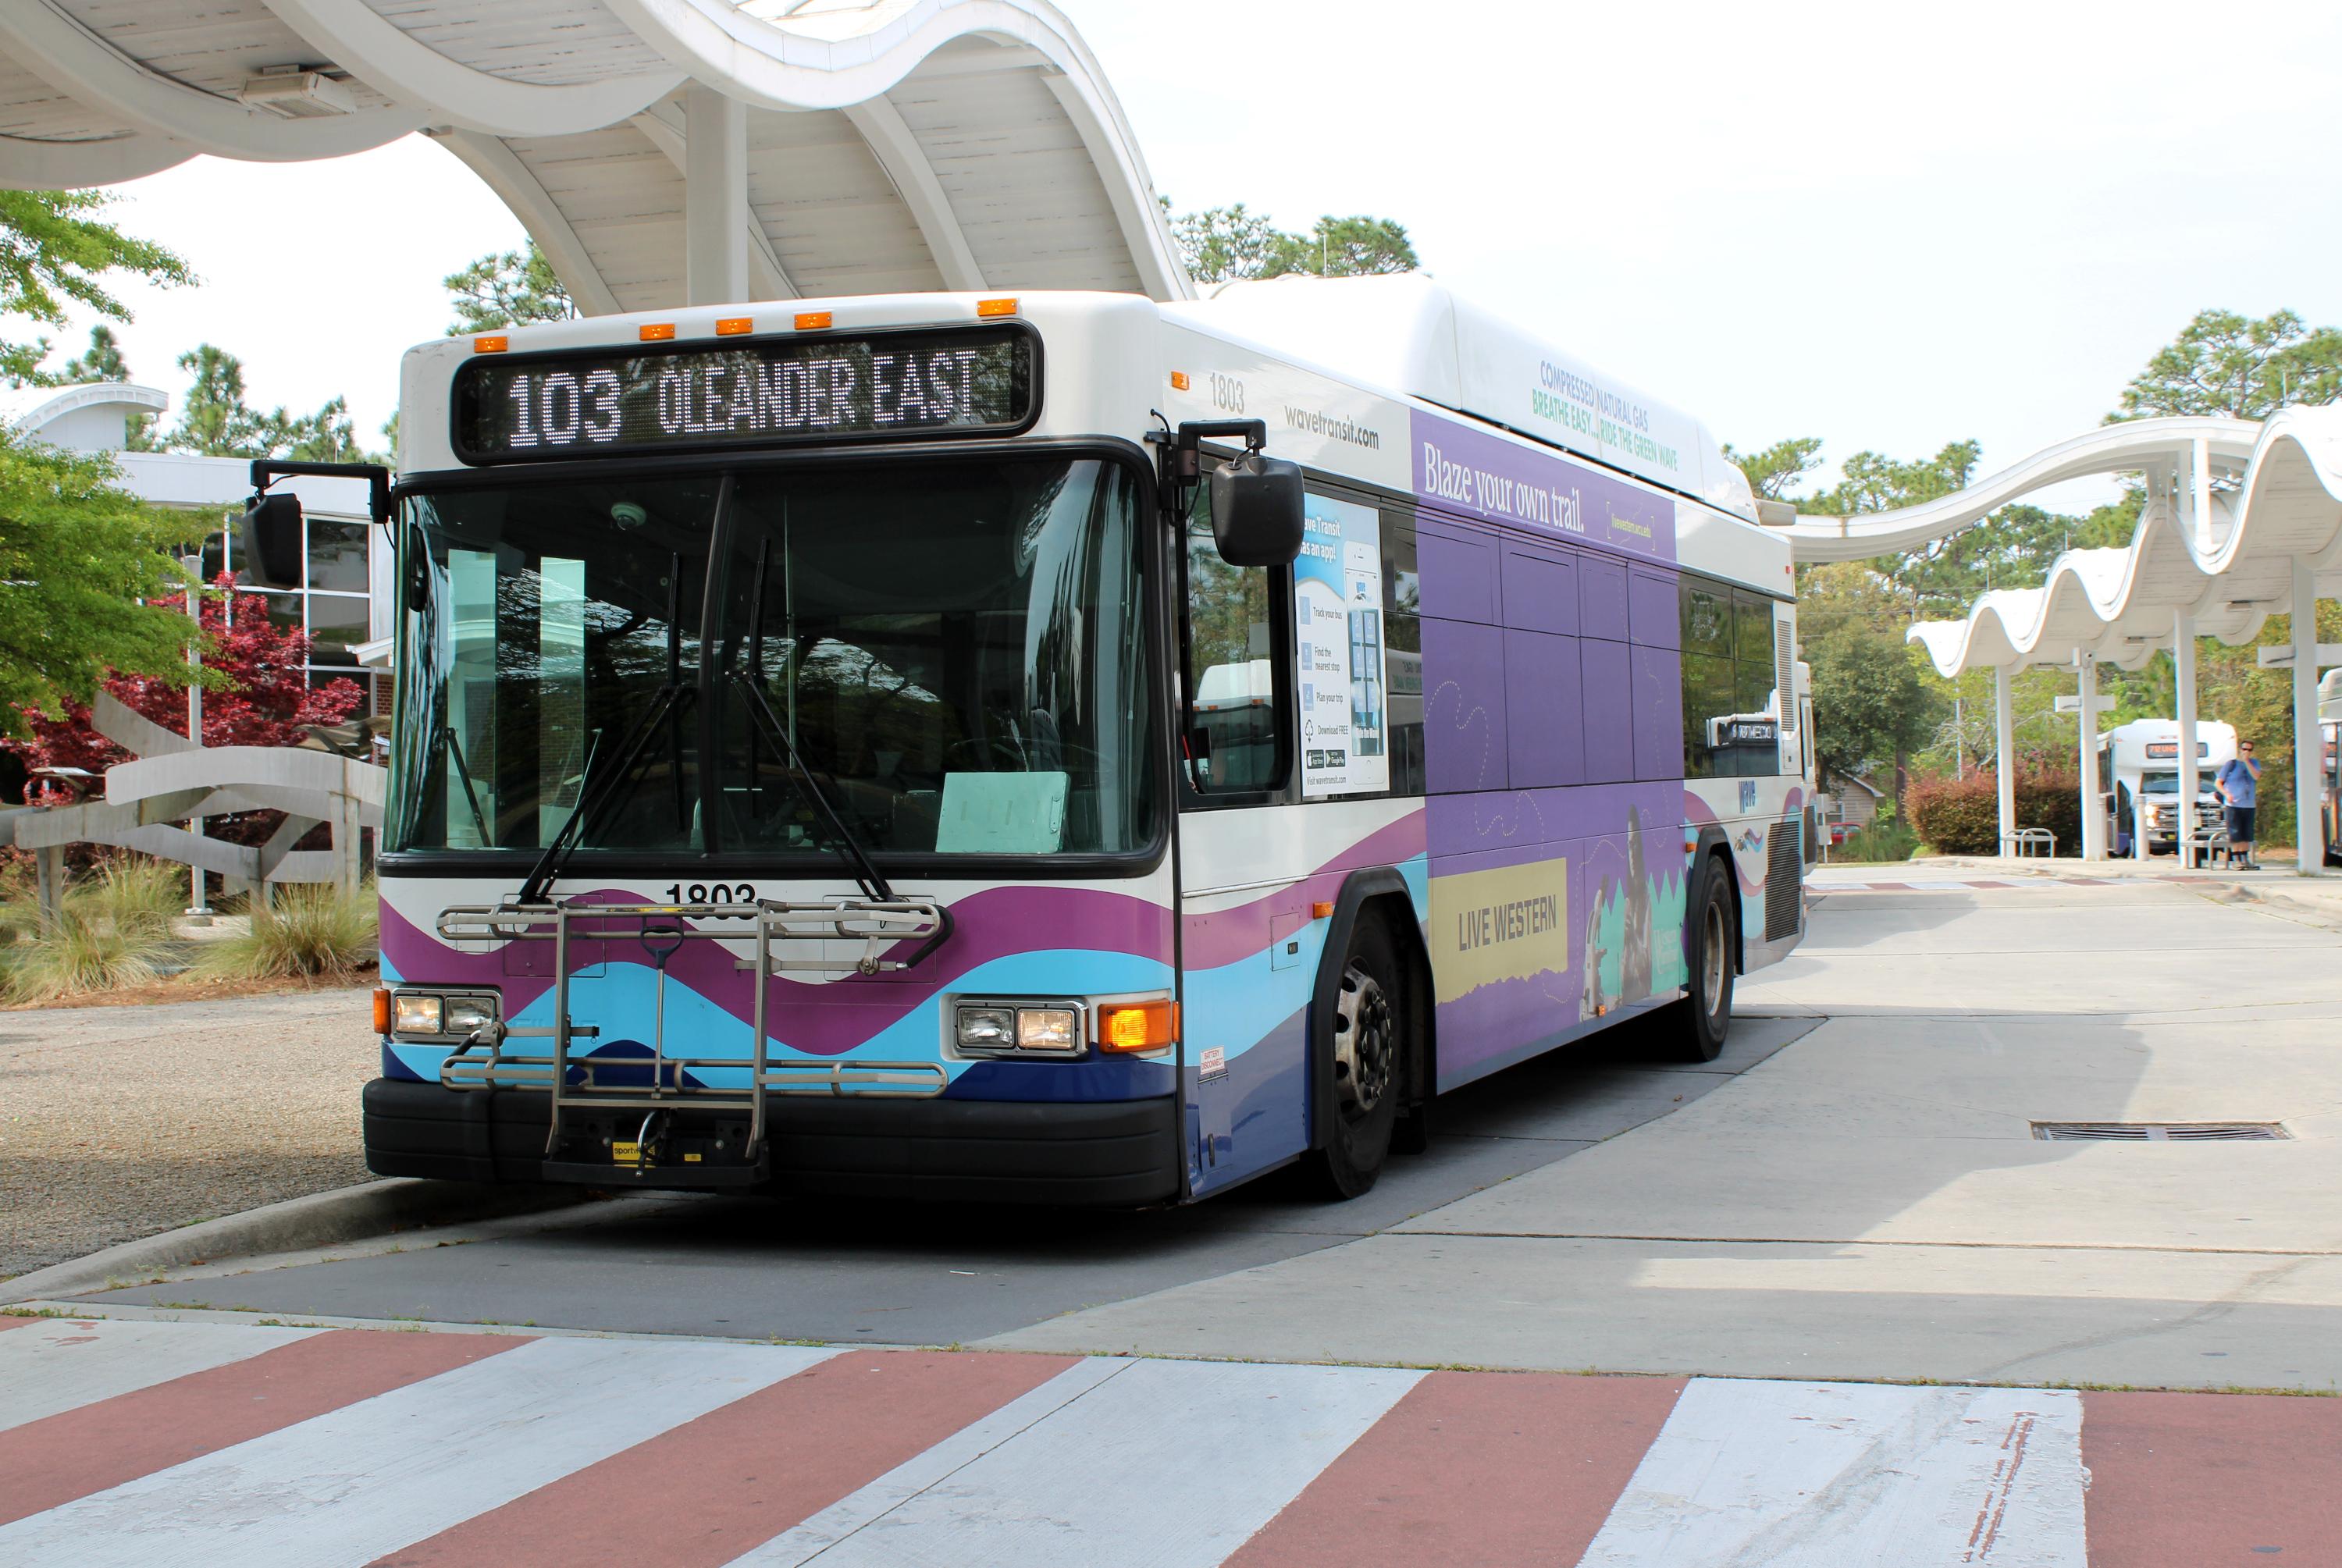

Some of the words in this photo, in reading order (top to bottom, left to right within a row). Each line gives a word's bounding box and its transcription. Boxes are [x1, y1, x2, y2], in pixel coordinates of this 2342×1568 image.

[510, 369, 621, 447] 103
[660, 358, 856, 434] OLEANDER
[874, 350, 976, 422] EAST
[1209, 372, 1244, 414] 1803
[1540, 360, 1594, 407] COMPRESSED
[1596, 388, 1632, 425] NATURAL
[1633, 405, 1648, 432] GAS
[1284, 405, 1379, 450] wavetransit.com
[1532, 388, 1569, 427] BREATHE
[1600, 418, 1618, 448] RIDE
[1618, 426, 1632, 454] THE
[1634, 433, 1657, 464] GREEN
[1658, 443, 1678, 472] WAVE
[1423, 442, 1472, 503] Blaze
[1475, 471, 1512, 516] your
[1516, 485, 1549, 524] own
[1552, 486, 1585, 534] trail.
[1304, 517, 1316, 533] ave
[1317, 516, 1341, 537] Transit
[1311, 542, 1320, 556] an
[1321, 543, 1337, 564] app!
[1313, 606, 1325, 617] Track
[1325, 611, 1334, 620] your
[1334, 609, 1343, 619] bus
[1315, 645, 1324, 656] Find
[1315, 661, 1331, 671] nearest
[1331, 663, 1340, 674] stop
[1316, 692, 1326, 702] Plan
[1326, 695, 1335, 704] your
[1318, 724, 1338, 735] Download
[1339, 725, 1348, 735] FREE
[1306, 776, 1316, 786] Visit
[1316, 775, 1347, 785] wavetransit.com
[666, 884, 756, 920] 1803
[1458, 908, 1490, 951] LIVE
[1493, 894, 1557, 943] WESTERN
[1201, 1058, 1223, 1069] DISCONNECT
[1204, 1049, 1219, 1060] BATTERY
